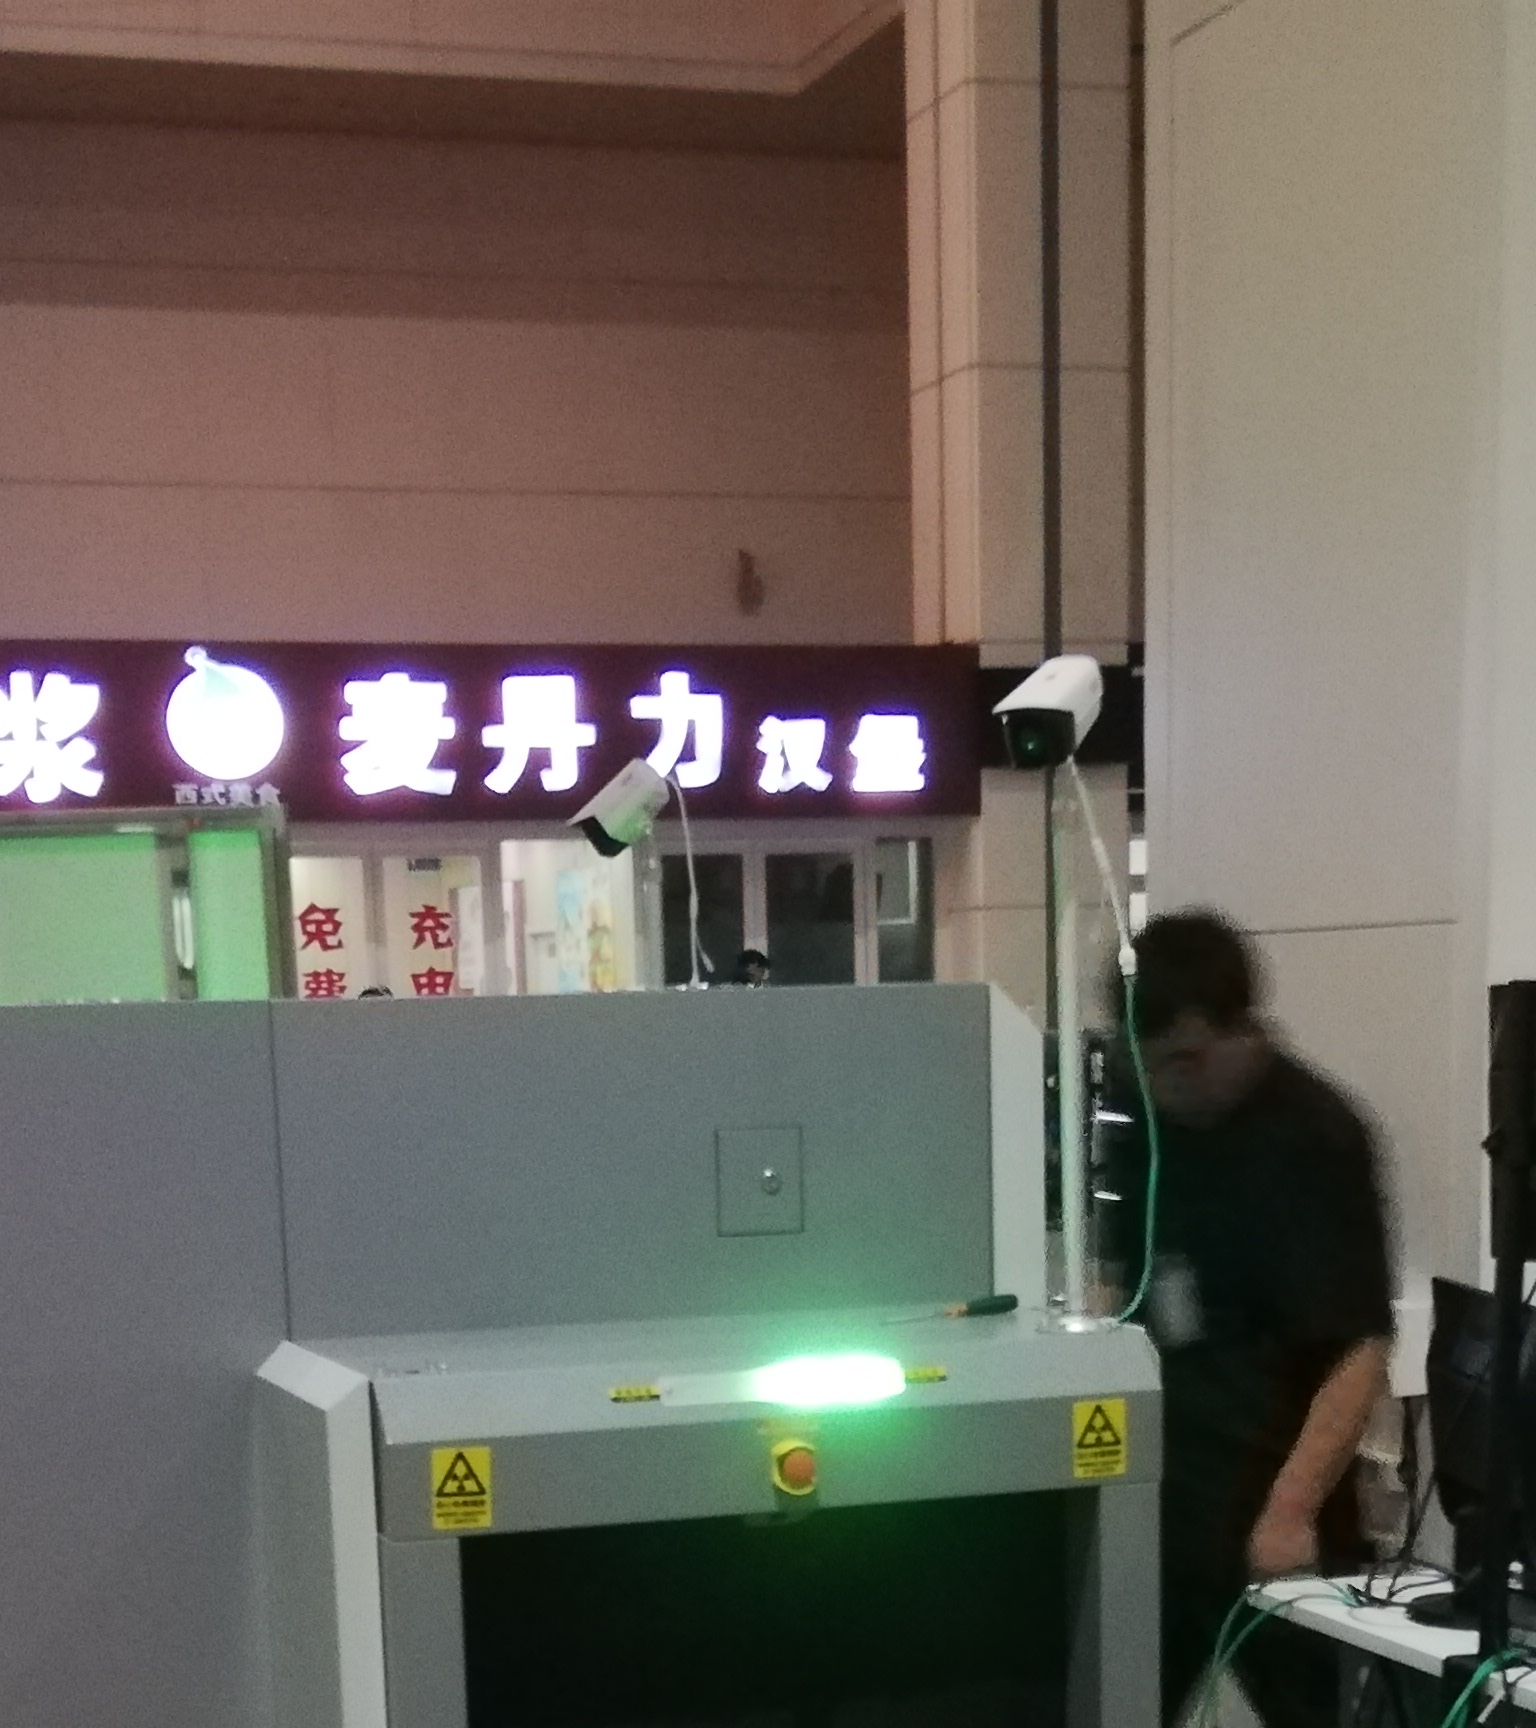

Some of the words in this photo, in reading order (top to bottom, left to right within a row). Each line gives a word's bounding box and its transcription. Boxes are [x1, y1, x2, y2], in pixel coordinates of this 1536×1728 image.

[338, 671, 725, 796] 麦丹力
[756, 714, 927, 794] 汉堡
